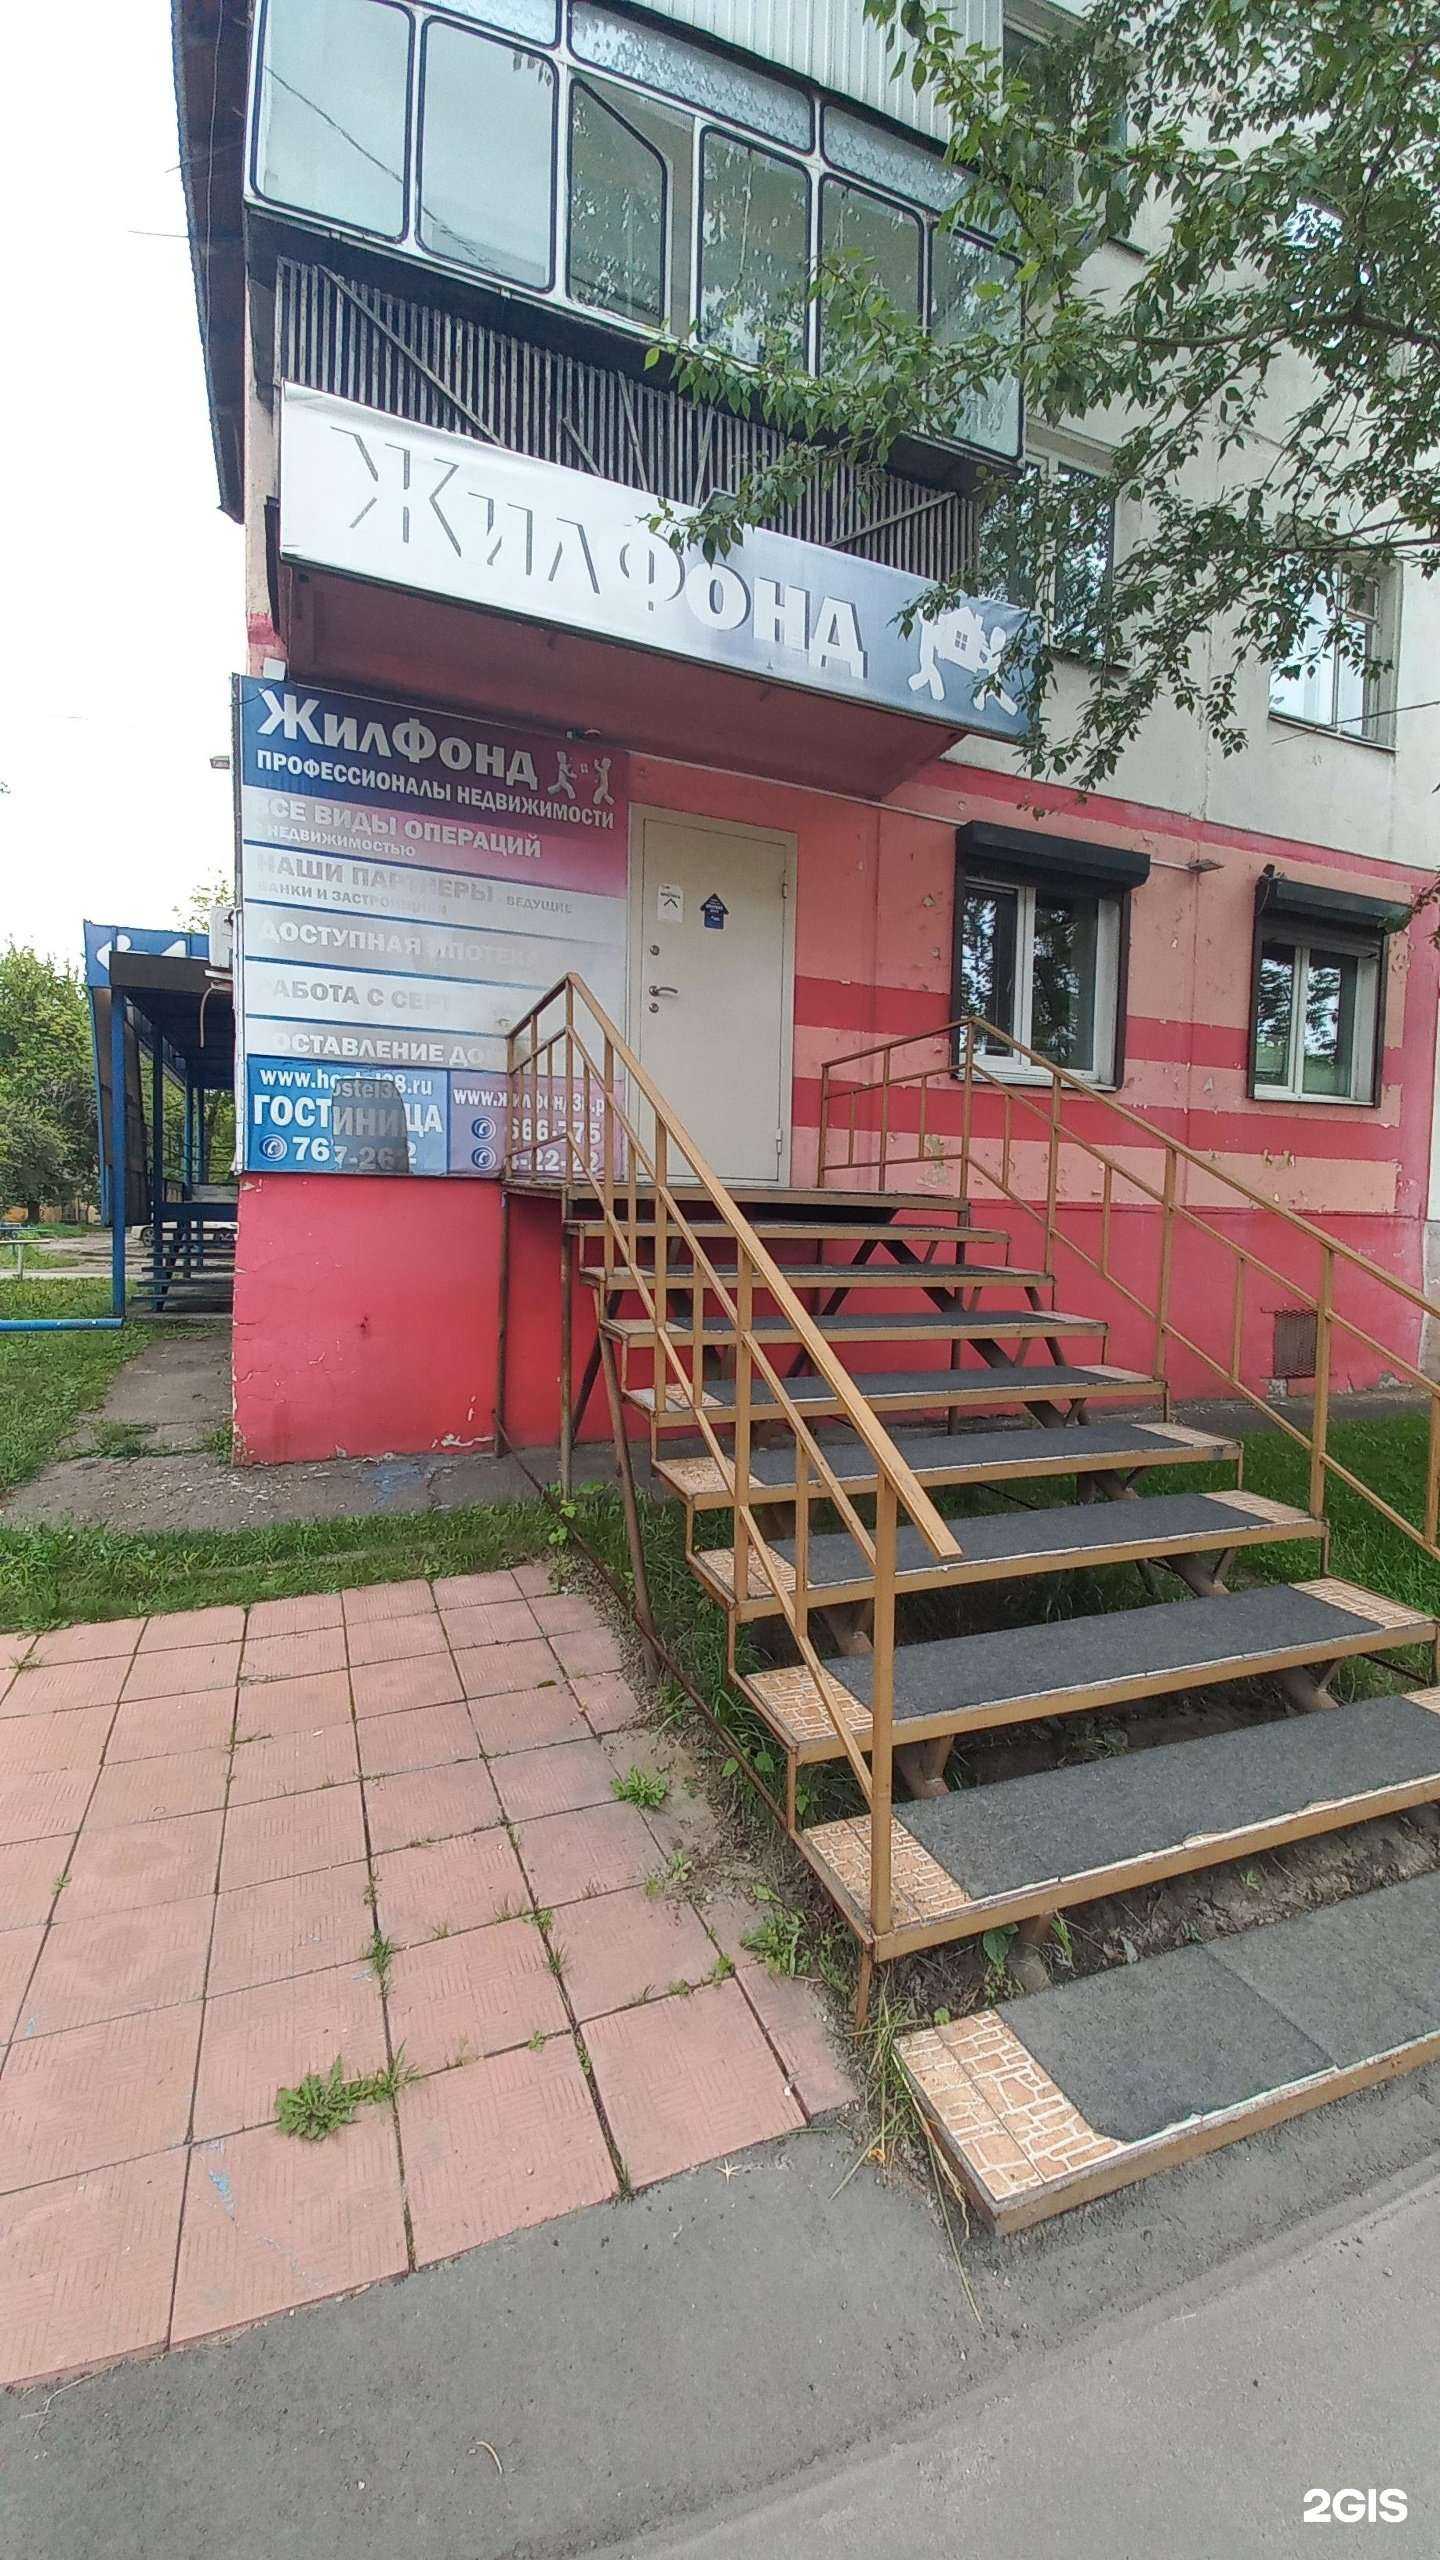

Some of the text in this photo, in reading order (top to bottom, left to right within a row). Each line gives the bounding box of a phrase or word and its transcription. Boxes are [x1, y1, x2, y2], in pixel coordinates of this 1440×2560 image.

[256, 748, 615, 830] ПРОФЕССИОНАЛЫ НЕДВИЖИМОСТИ
[268, 825, 416, 857] НЕДВИЖИМОСТЬЮ
[314, 804, 397, 836] ВИДЫ
[404, 819, 542, 859] ОПЕРАЦИЙ
[317, 887, 328, 899] И
[352, 866, 494, 903] ПАРНЕРЫ
[506, 894, 573, 914] ВЕДУЩИЕ
[259, 921, 422, 956] ДОСТУПНАЯ
[264, 978, 360, 1006] АБОТА
[253, 1094, 443, 1138] ГОСТИНИЦА
